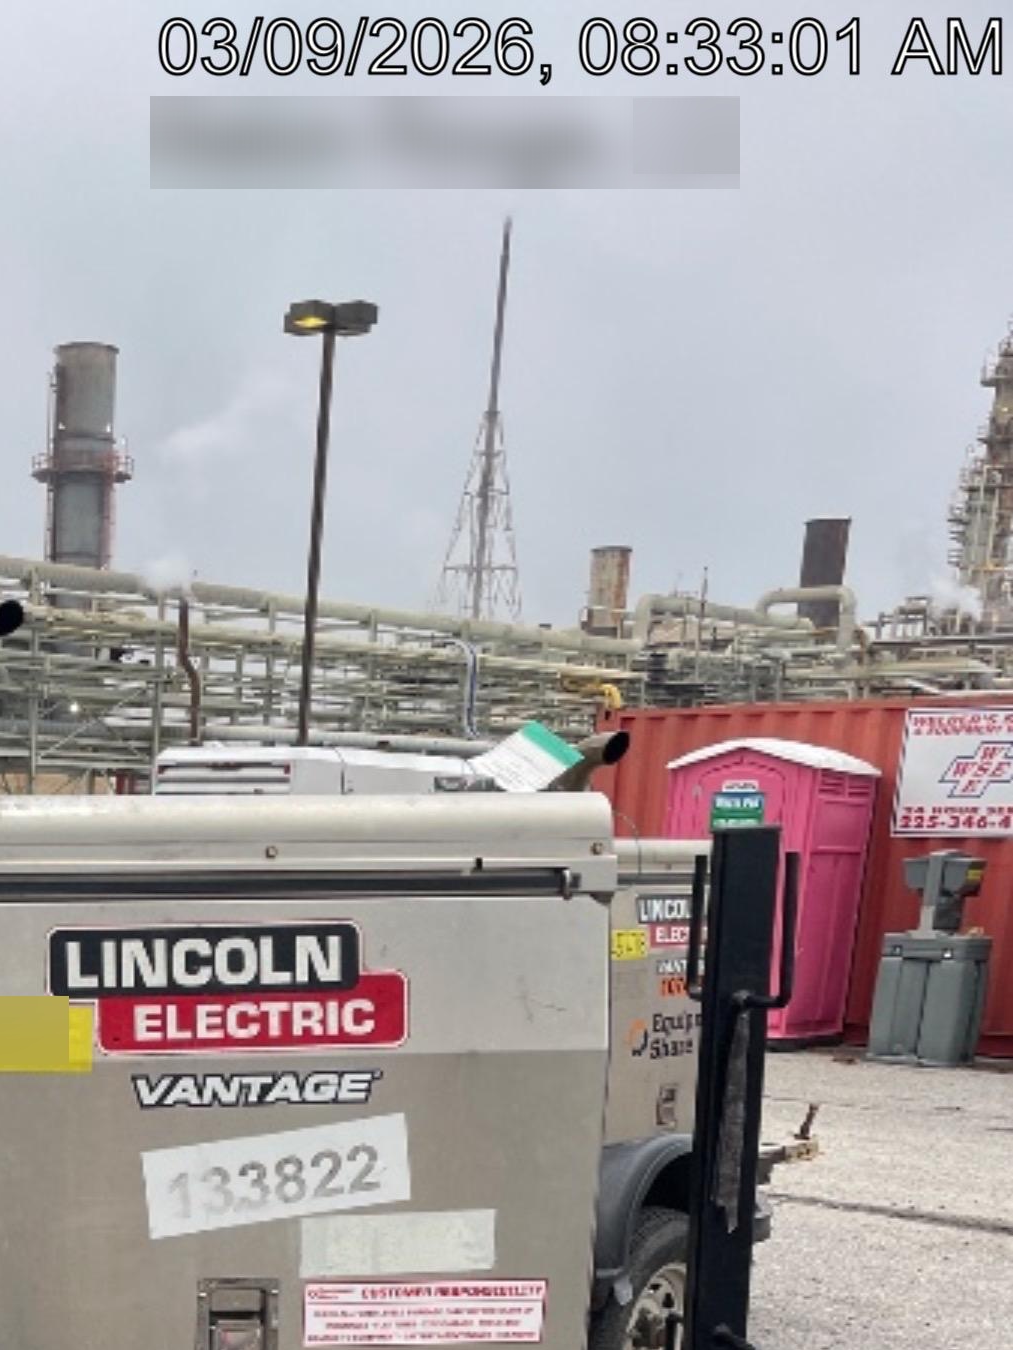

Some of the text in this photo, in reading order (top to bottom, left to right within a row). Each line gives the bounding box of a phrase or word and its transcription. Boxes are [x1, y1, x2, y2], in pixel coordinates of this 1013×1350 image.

[952, 762, 1011, 778] WSE
[64, 933, 343, 990] LINCOLN
[132, 997, 376, 1042] ELECTRIC
[649, 1037, 694, 1061] Share
[133, 1070, 375, 1108] VANTAGE
[166, 1142, 382, 1221] 133822
